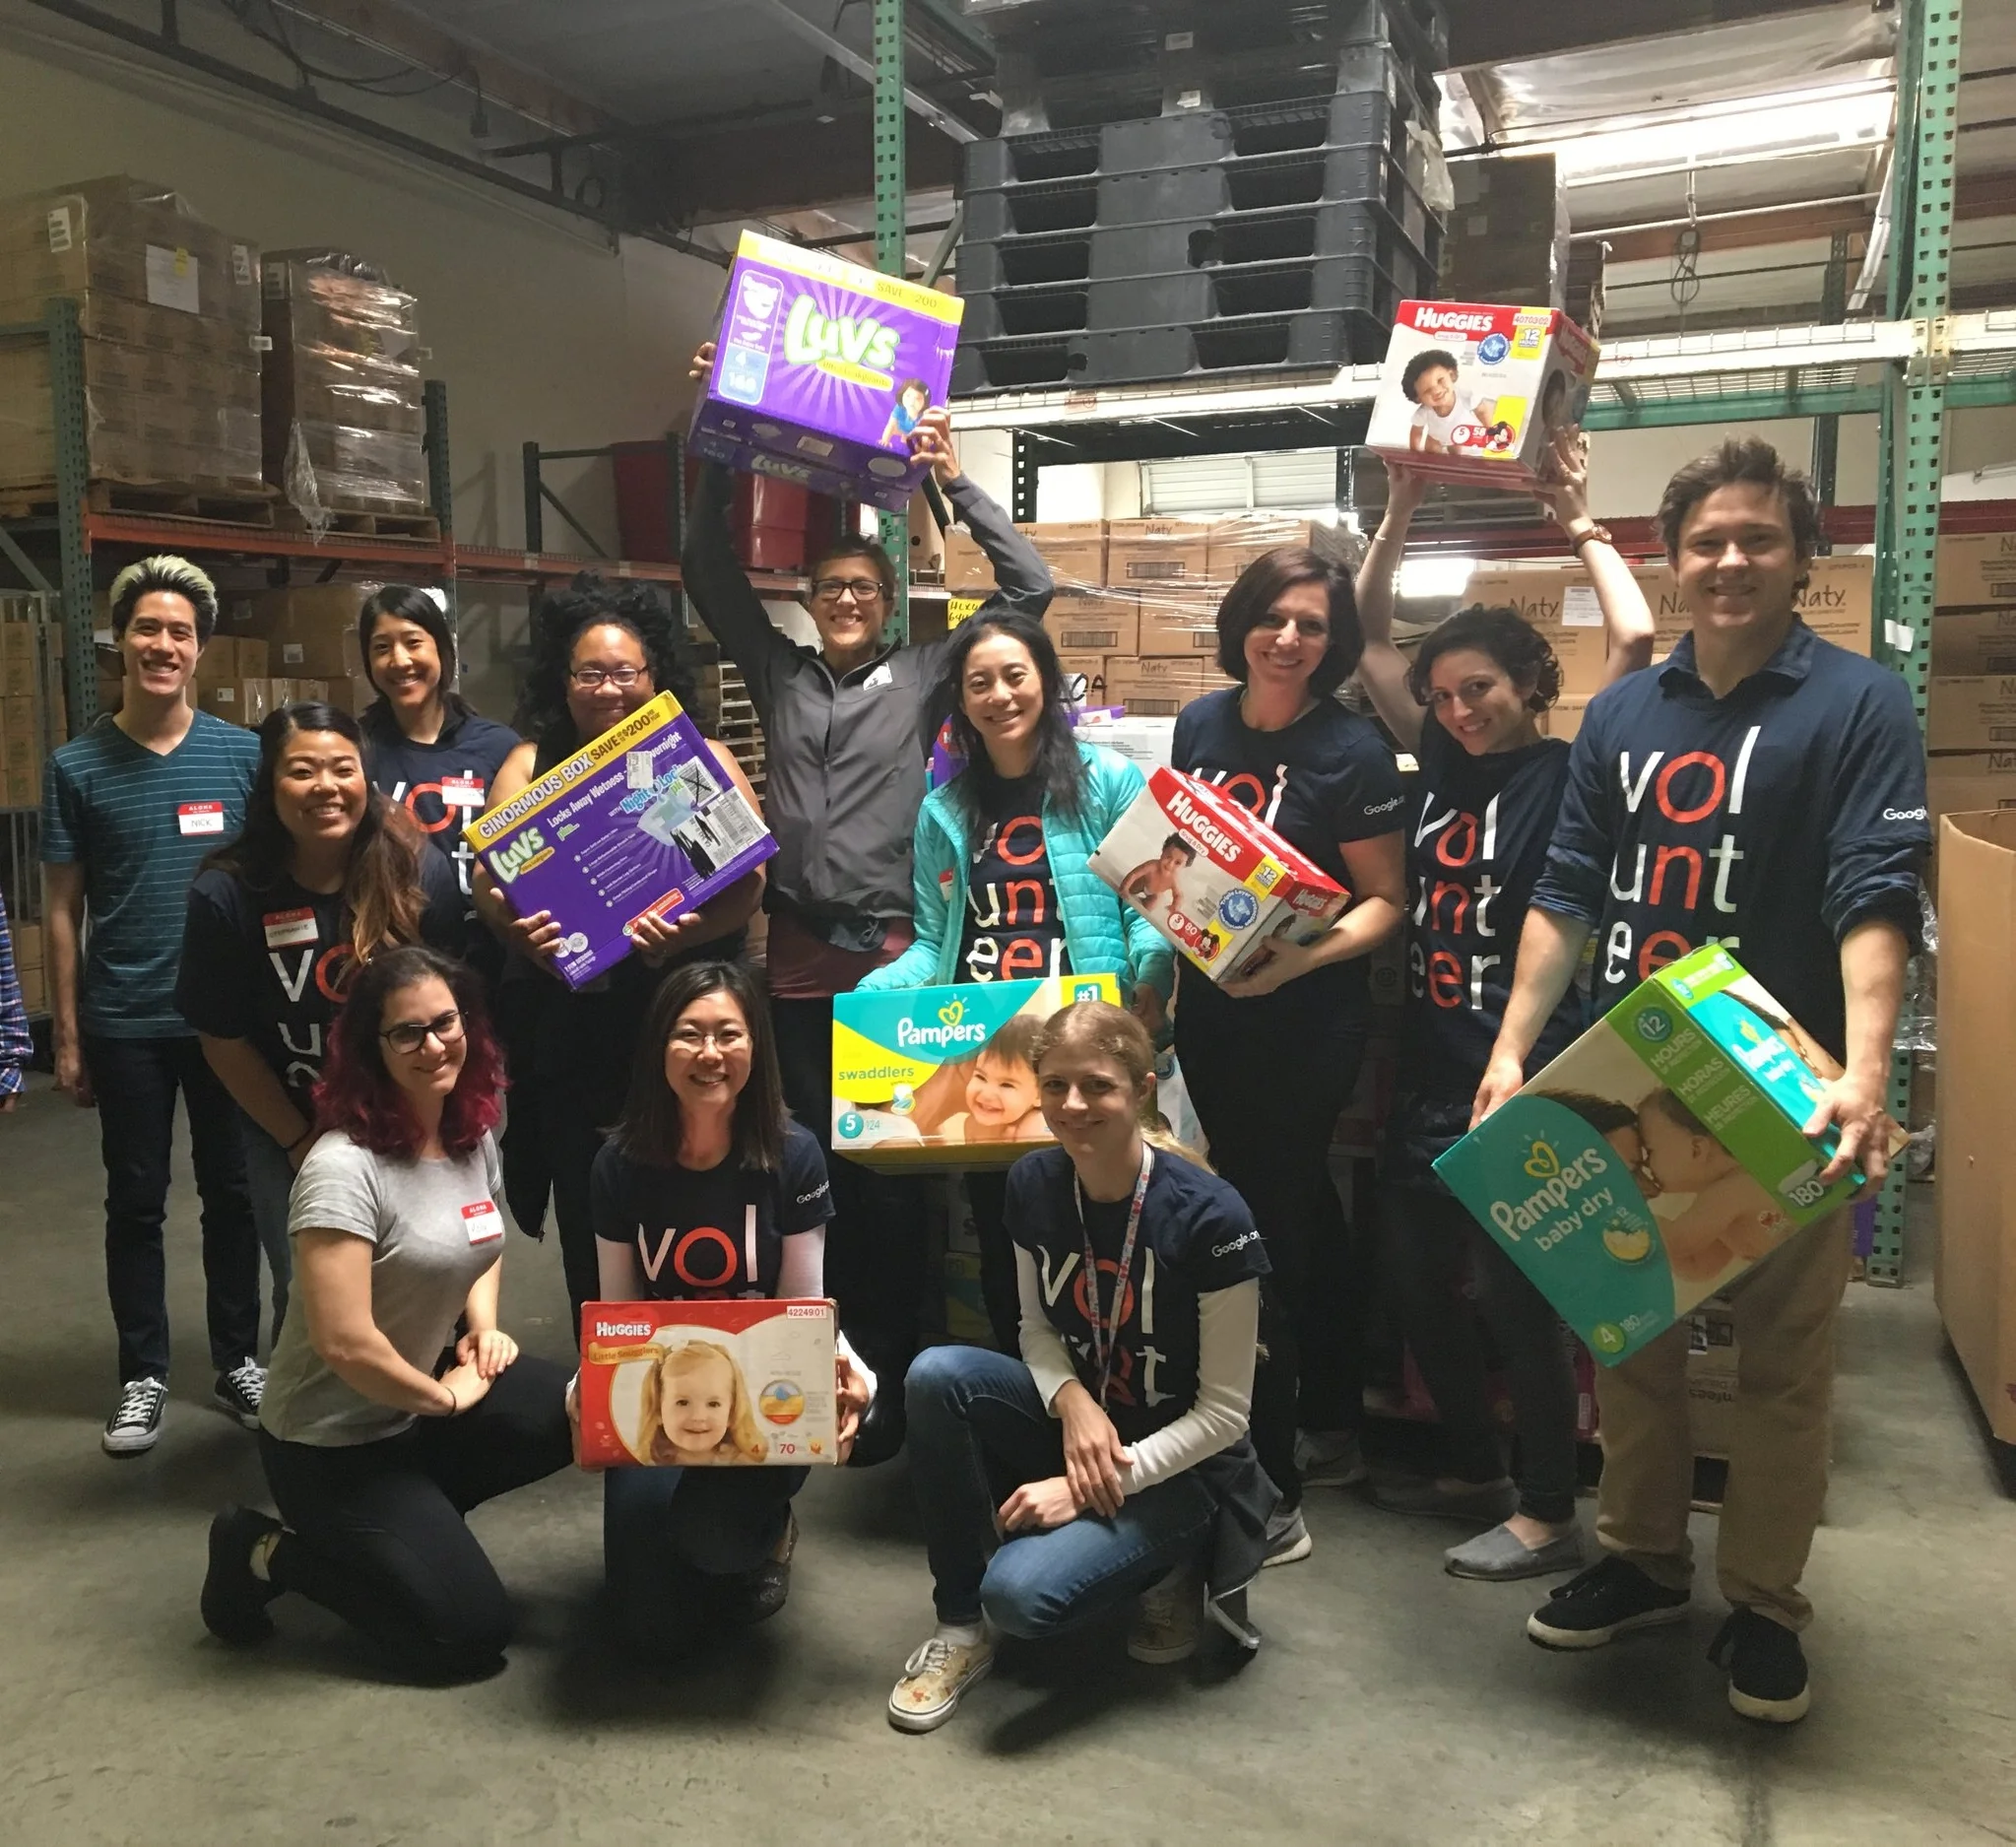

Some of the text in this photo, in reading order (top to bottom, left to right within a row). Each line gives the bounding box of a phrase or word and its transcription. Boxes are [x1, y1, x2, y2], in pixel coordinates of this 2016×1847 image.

[784, 294, 900, 369] Luvs
[1414, 306, 1494, 332] HUGGIES
[1523, 327, 1542, 342] 12
[1472, 427, 1486, 437] 58
[478, 774, 564, 839] GINORMOUS
[558, 751, 596, 783] BOX
[590, 734, 622, 761] SAVE
[1619, 725, 1762, 825] vol
[546, 807, 573, 829] Locks
[570, 793, 595, 817] Away
[589, 769, 626, 799] Wetness
[607, 804, 623, 818] WITH
[619, 788, 652, 816] Night
[191, 818, 214, 828] NICK
[1165, 789, 1242, 863] HUGGIES
[1413, 790, 1502, 867] vol
[487, 825, 546, 885] Luvs
[1262, 865, 1279, 882] 12
[1609, 833, 1744, 914] unt
[1174, 915, 1198, 936] 3 80
[897, 1017, 986, 1048] Pampers
[1641, 1015, 1666, 1035] 12
[1649, 1027, 1697, 1068] HOURS
[837, 1066, 915, 1081] swaddlers
[1676, 1057, 1724, 1096] HORAS
[1702, 1085, 1752, 1125] HEURES
[844, 1114, 880, 1132] 5 124
[1489, 1146, 1609, 1243] Pampers
[1788, 1180, 1826, 1209] 180
[1533, 1185, 1614, 1254] baby dry
[638, 1203, 758, 1287] vol
[1036, 1243, 1156, 1335] vol
[787, 1307, 825, 1318] 4224901
[595, 1321, 652, 1338] HUGGIES
[1600, 1314, 1642, 1345] 4 180
[593, 1352, 617, 1361] Little
[750, 1442, 797, 1456] 4 70
